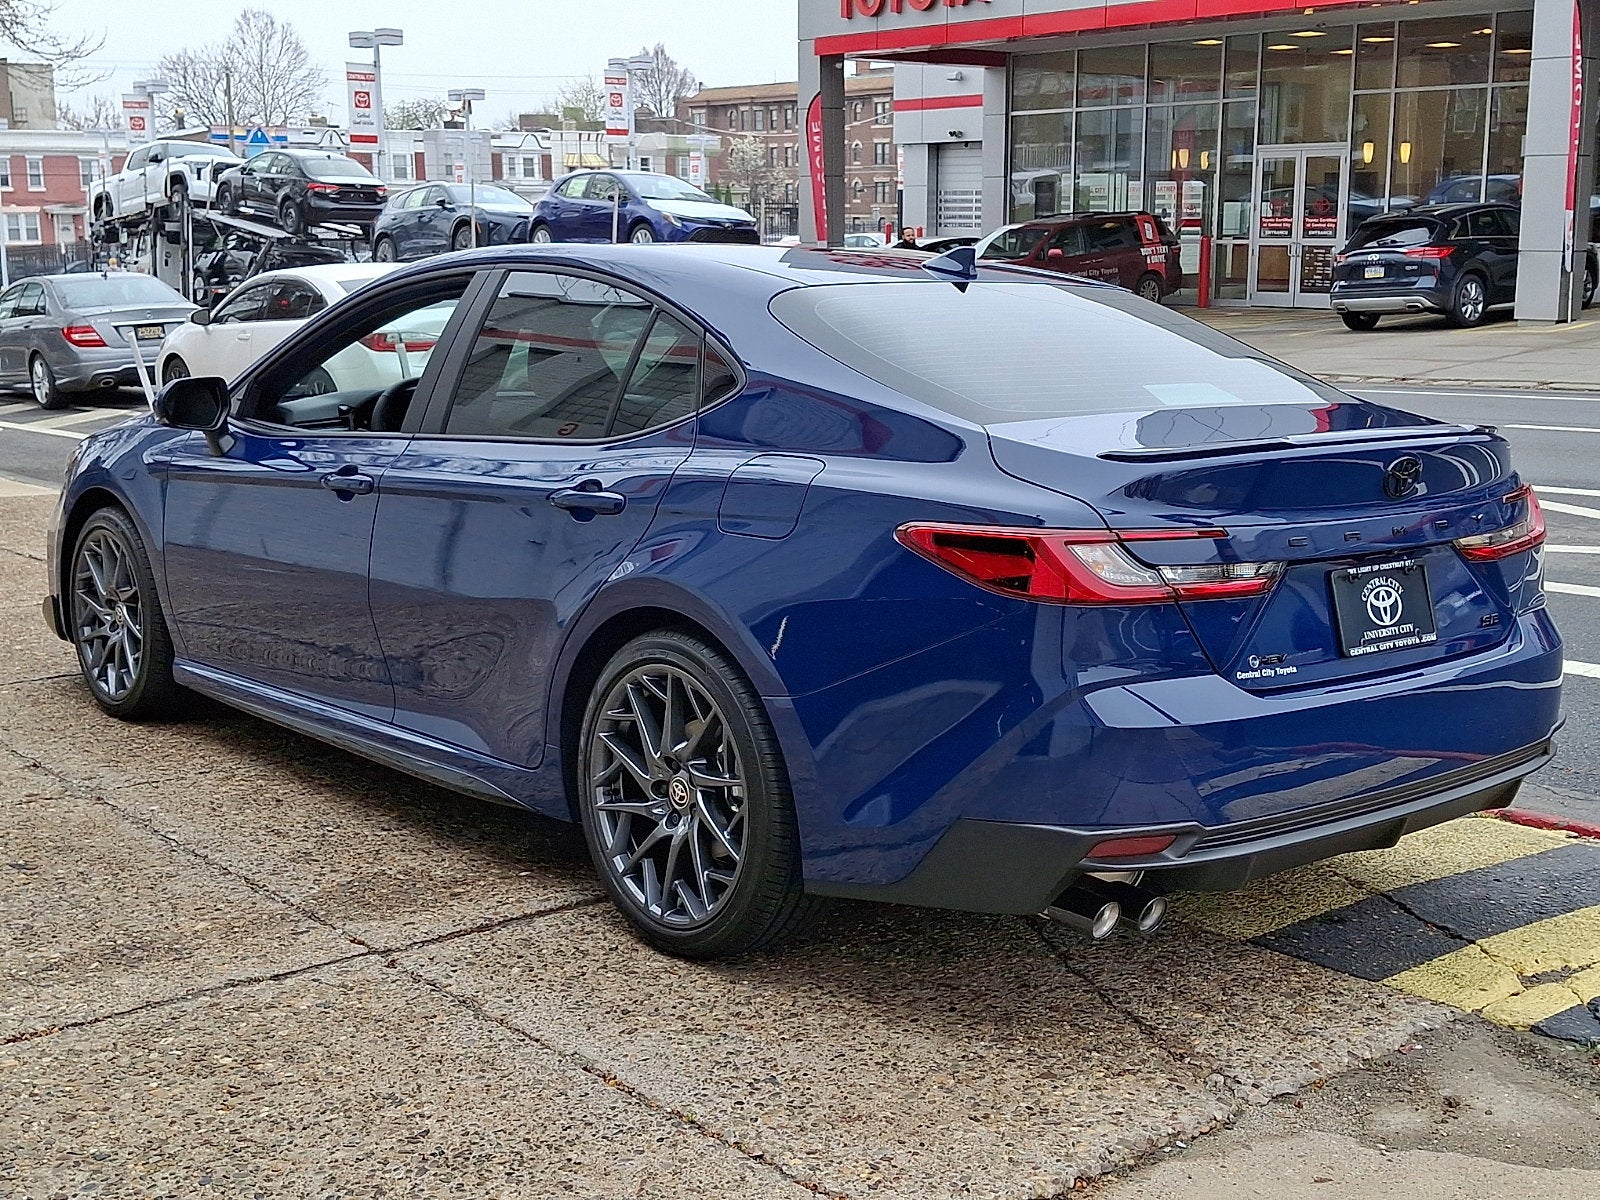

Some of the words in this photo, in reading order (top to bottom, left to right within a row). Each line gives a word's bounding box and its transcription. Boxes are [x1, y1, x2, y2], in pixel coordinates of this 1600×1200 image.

[1088, 268, 1100, 276] City
[1101, 267, 1119, 275] Toyota
[1380, 560, 1404, 570] CHESTNUT
[1361, 576, 1388, 602] CENTRAL
[1387, 577, 1405, 595] CITY
[1480, 613, 1499, 628] SE
[1363, 625, 1400, 640] UNIVERSITY
[1400, 623, 1414, 634] CITY
[1349, 645, 1379, 657] CENTRAL
[1379, 642, 1394, 651] CITY
[1394, 637, 1420, 648] TOYOTA
[1236, 670, 1260, 680] Central
[1261, 668, 1274, 678] City
[1275, 666, 1298, 676] Toyota
